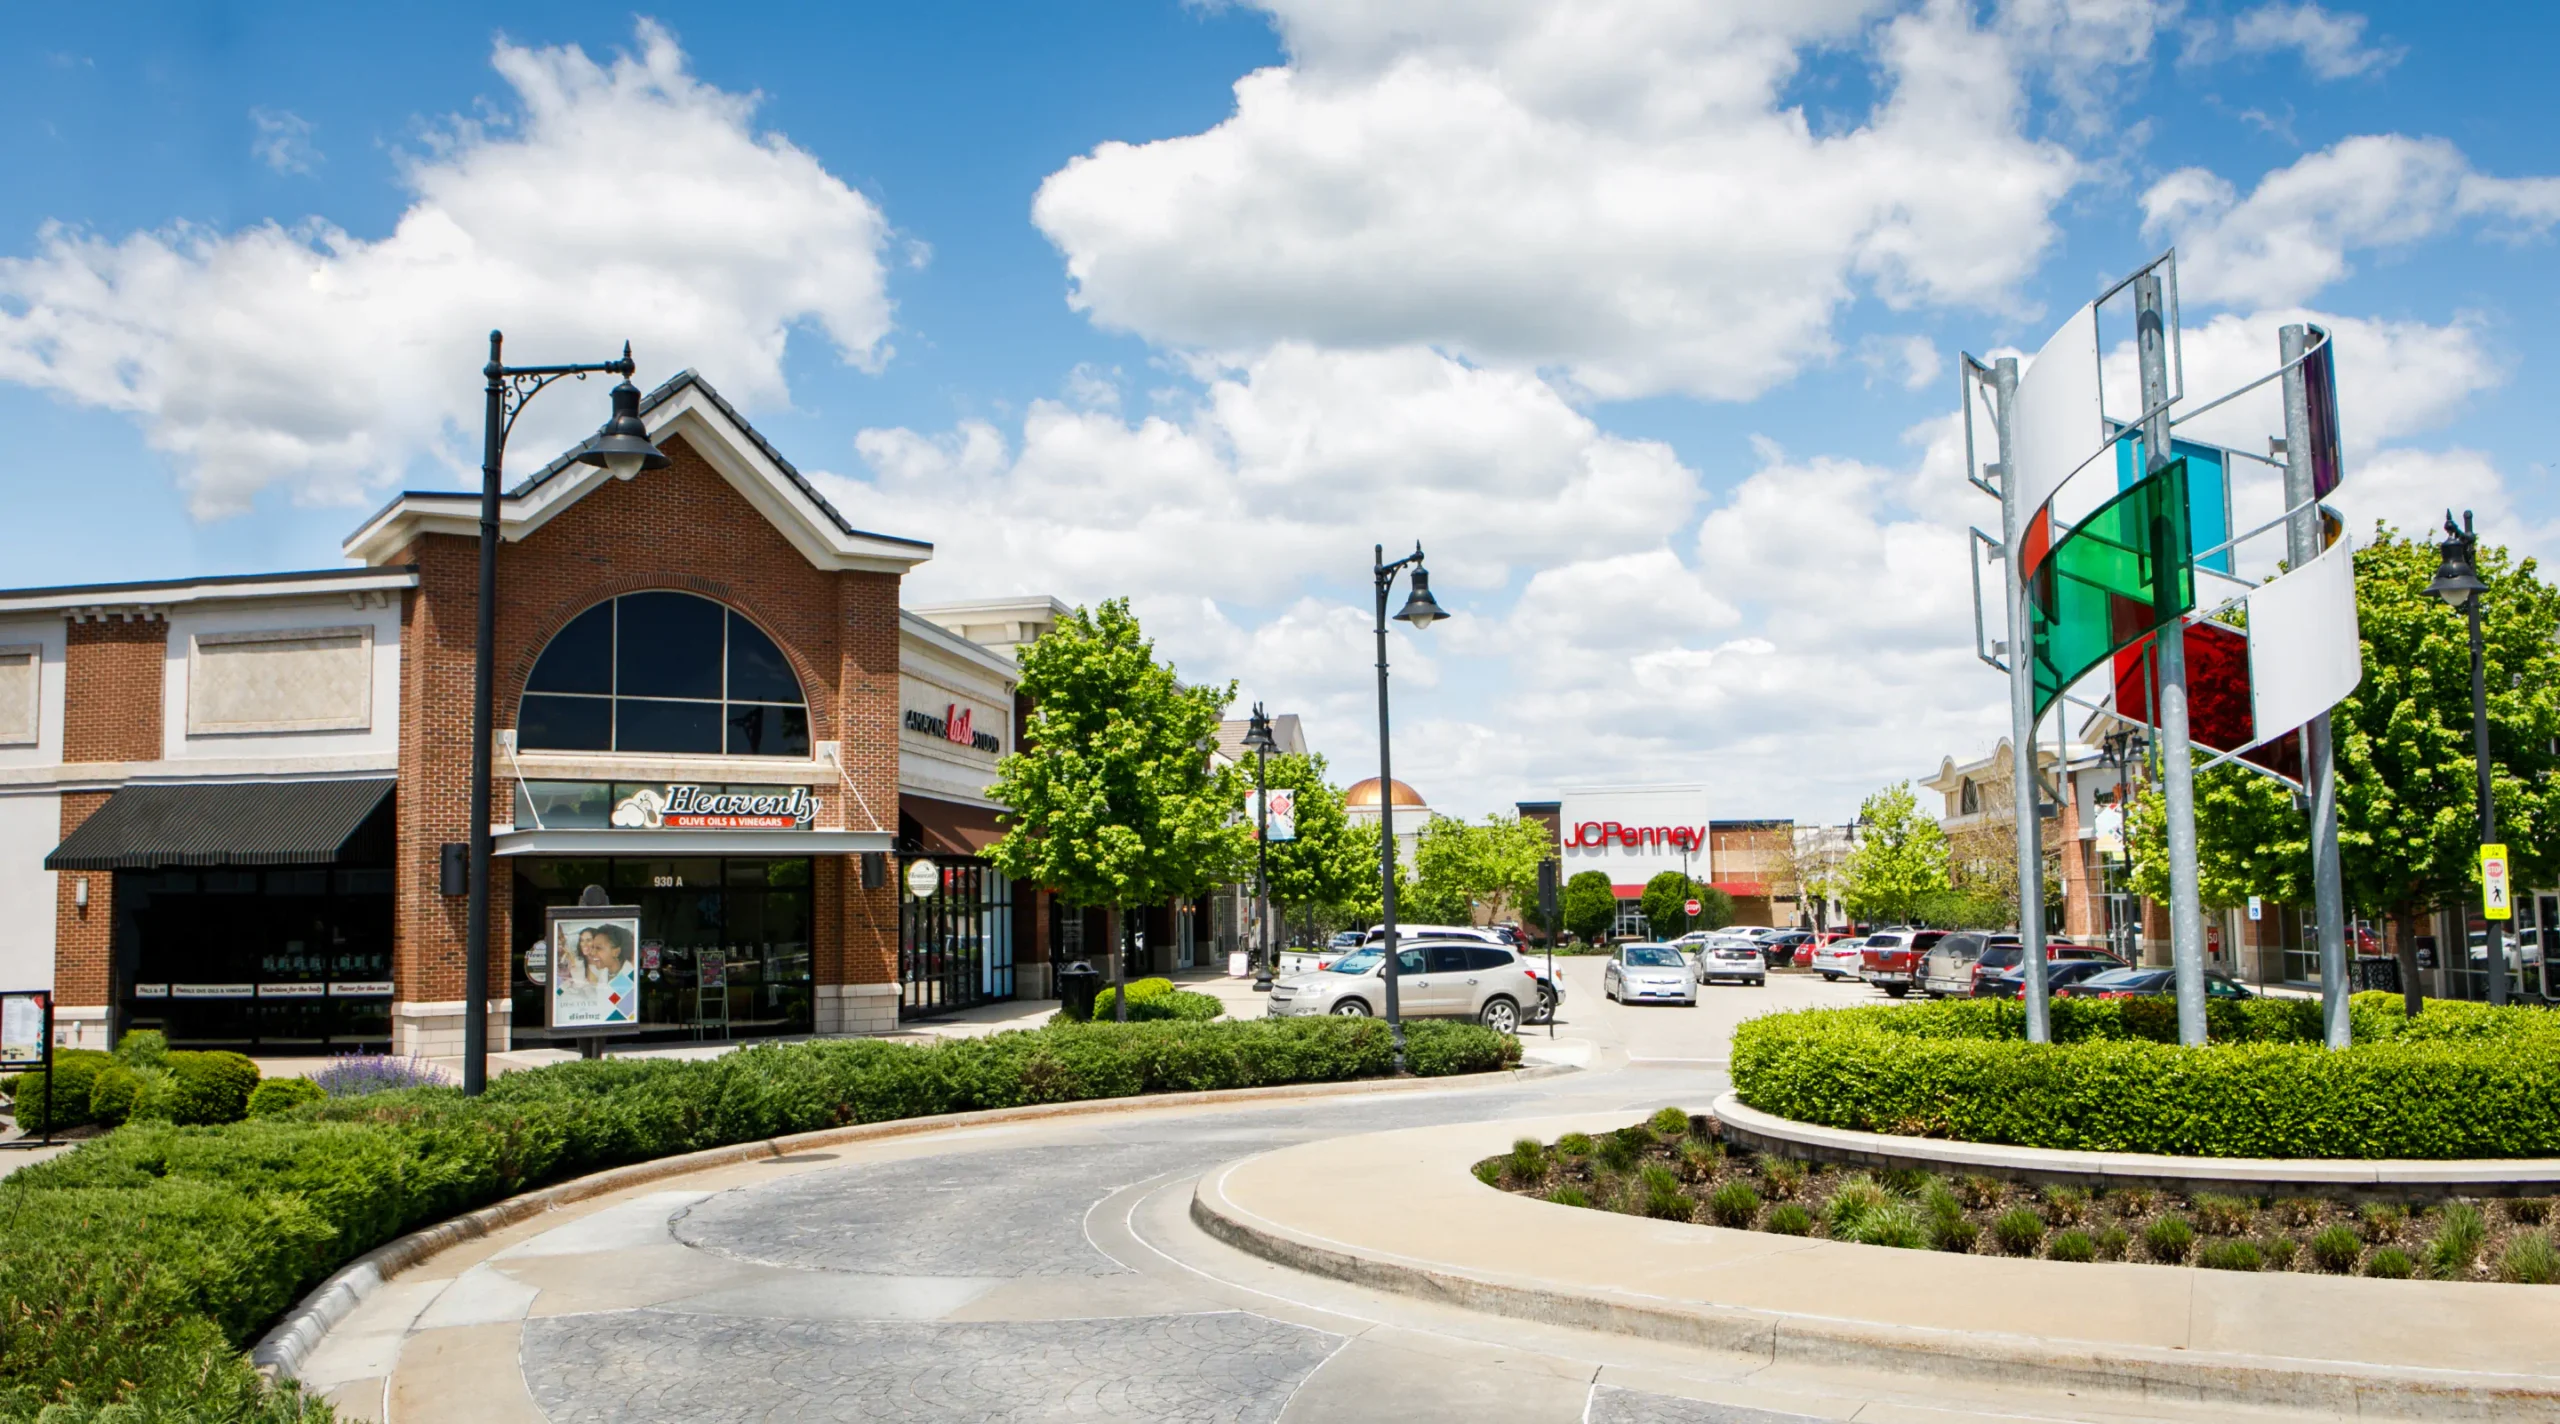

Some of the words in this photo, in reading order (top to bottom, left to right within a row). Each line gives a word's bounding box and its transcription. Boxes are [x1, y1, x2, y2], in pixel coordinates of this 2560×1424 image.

[946, 703, 975, 745] lash
[972, 730, 1000, 753] STUDIO
[662, 784, 822, 824] Heavenly
[678, 816, 705, 826] OLIVE
[707, 816, 728, 827] OILS
[729, 817, 736, 827] &
[738, 817, 782, 827] VINEGARS
[1564, 821, 1706, 852] JCPenney
[654, 876, 673, 887] 930
[675, 876, 683, 887] A
[1686, 903, 1700, 911] STOP
[2208, 932, 2218, 944] 50
[568, 1012, 600, 1020] dining
